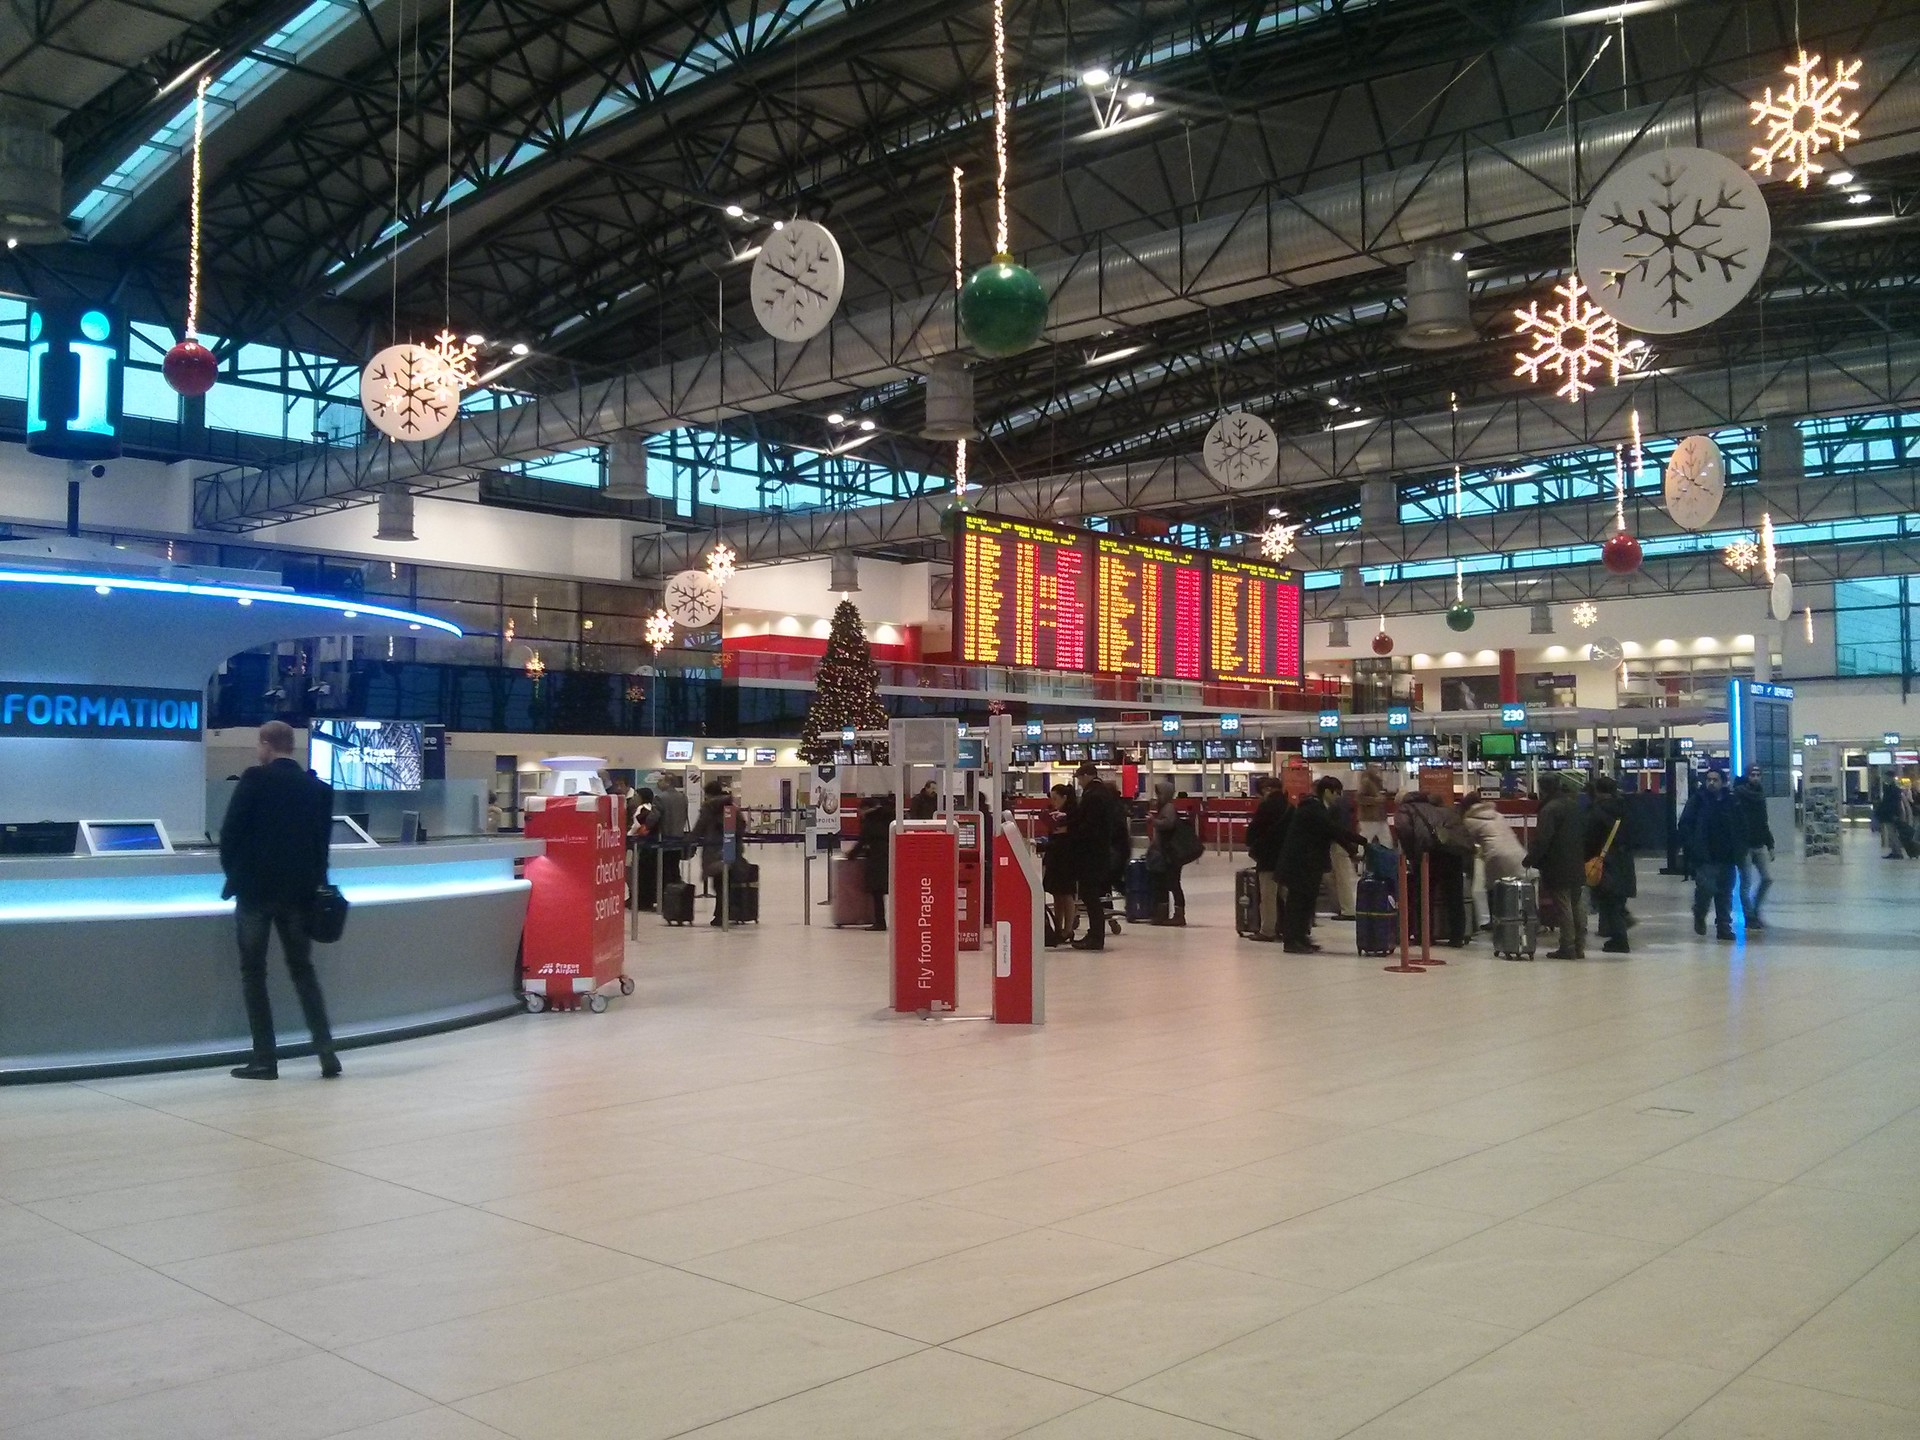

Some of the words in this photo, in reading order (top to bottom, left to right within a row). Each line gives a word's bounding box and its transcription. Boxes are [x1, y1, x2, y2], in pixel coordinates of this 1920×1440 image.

[1389, 714, 1407, 725] 231
[1503, 709, 1524, 721] 230
[1162, 721, 1179, 731] 234
[1221, 719, 1239, 730] 233
[1320, 716, 1338, 727] 232
[1027, 725, 1042, 735] 236
[1078, 723, 1093, 734] 235
[1680, 740, 1693, 748] 213
[1804, 738, 1818, 746] 211
[1884, 736, 1899, 745] 210
[596, 855, 625, 885] check-in
[595, 890, 620, 921] service
[917, 877, 935, 927] Prague
[917, 931, 932, 964] from
[917, 967, 935, 989] Fly
